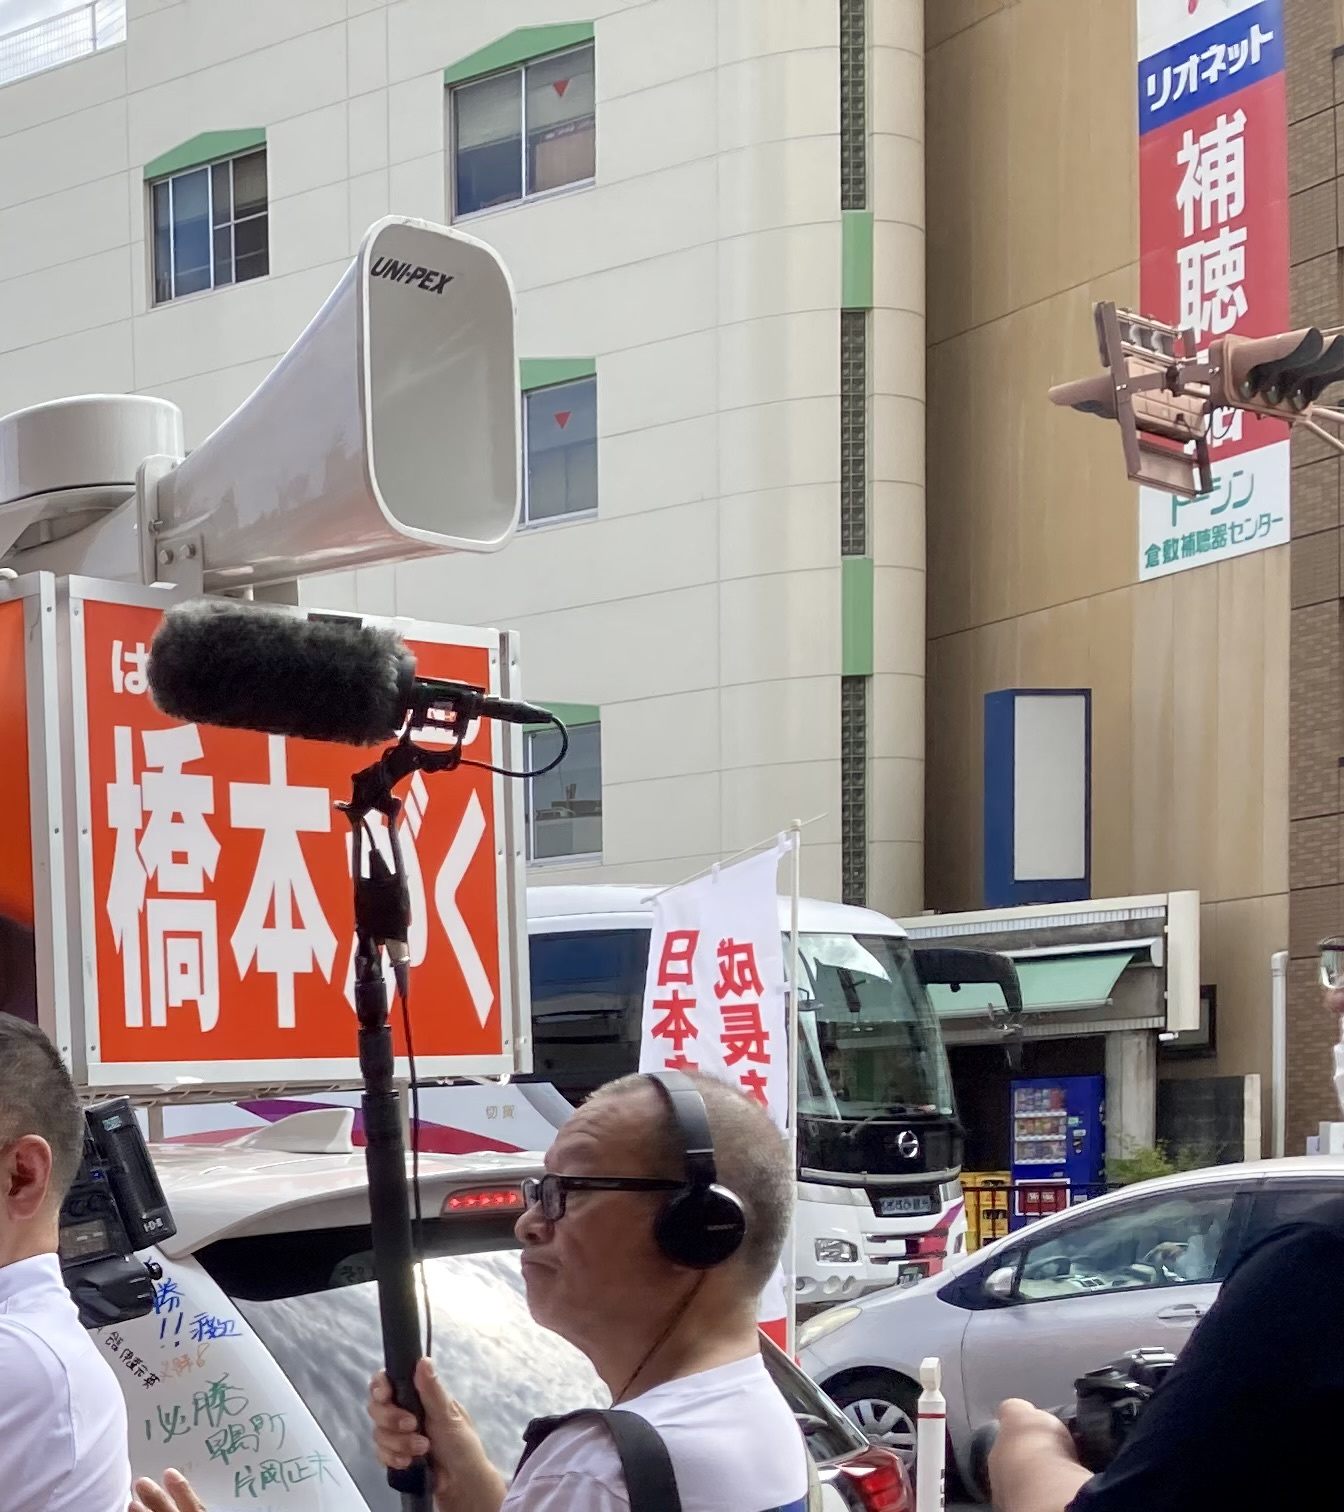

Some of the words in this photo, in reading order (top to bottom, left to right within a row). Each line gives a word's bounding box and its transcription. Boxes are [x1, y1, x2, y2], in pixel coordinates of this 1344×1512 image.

[1147, 24, 1274, 112] リオネット
[1144, 512, 1284, 569] 倉敷補聴器センター
